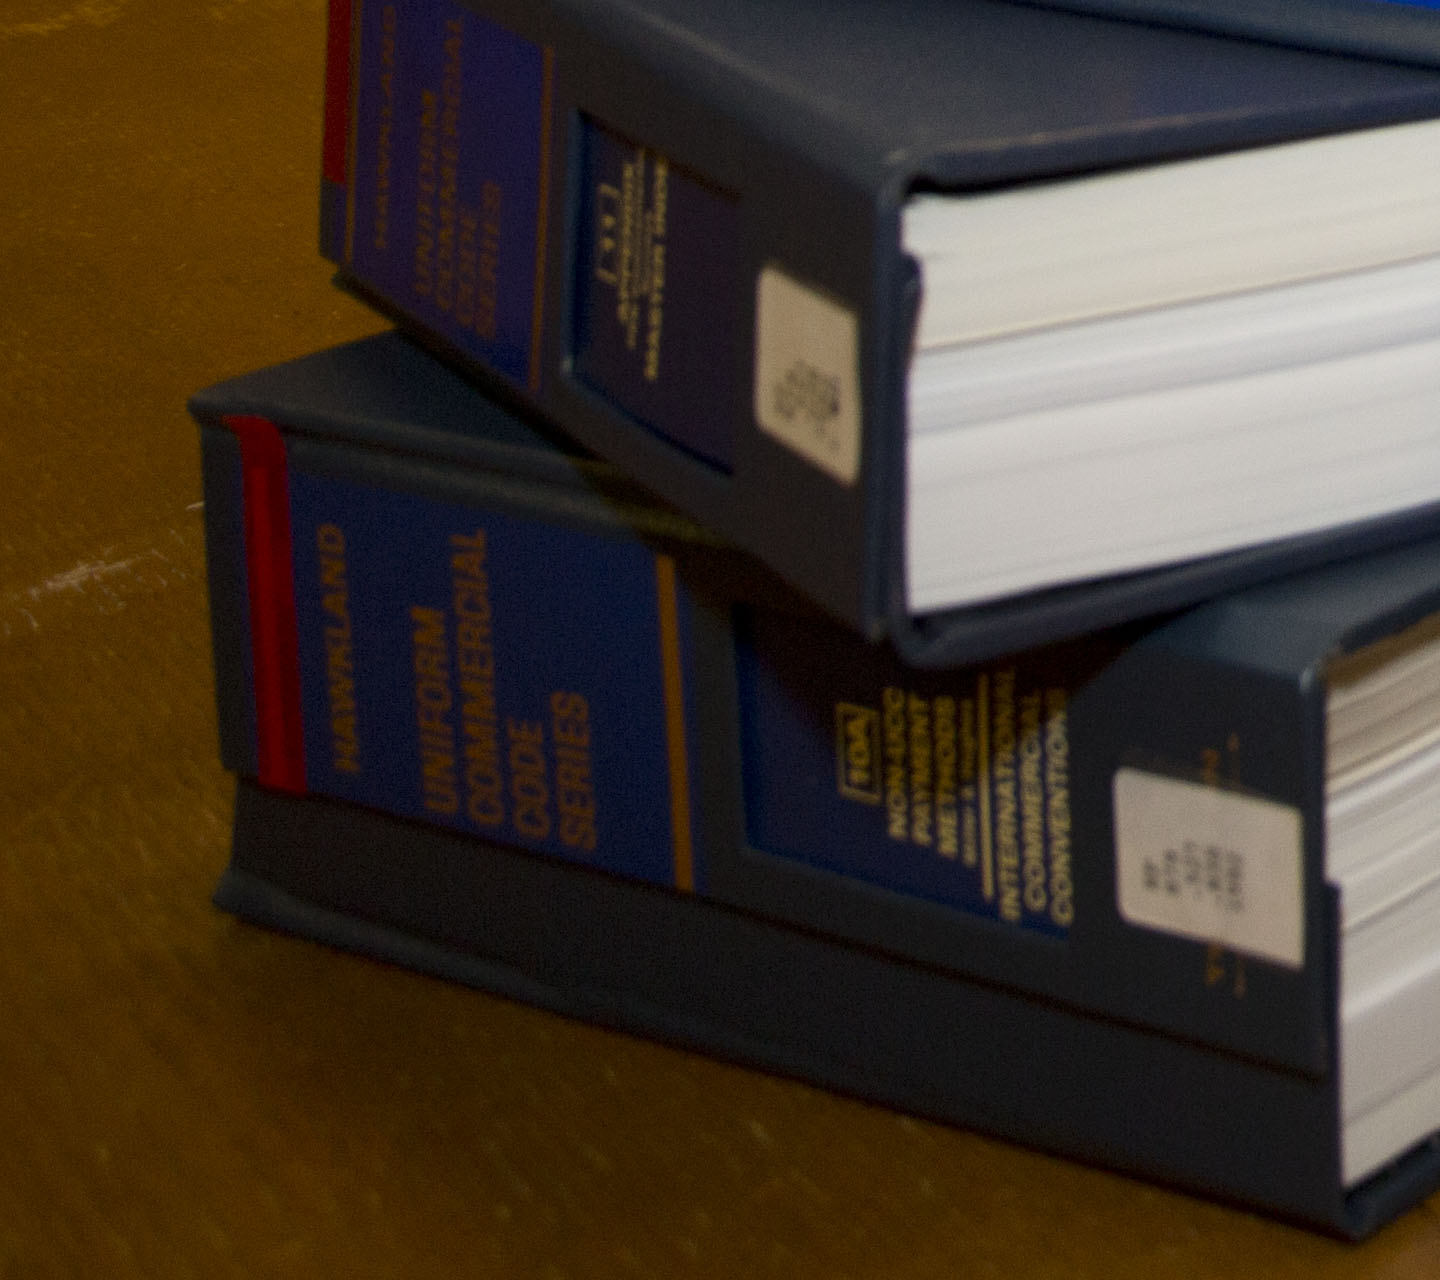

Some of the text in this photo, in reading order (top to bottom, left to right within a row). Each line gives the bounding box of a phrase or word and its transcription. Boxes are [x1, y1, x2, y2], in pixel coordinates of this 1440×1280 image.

[317, 523, 360, 775] HAWKLAND
[411, 605, 458, 815] UNIFORM
[451, 529, 504, 826] COMMERCIAL
[507, 715, 551, 839] CODE
[551, 690, 597, 851] SERIES
